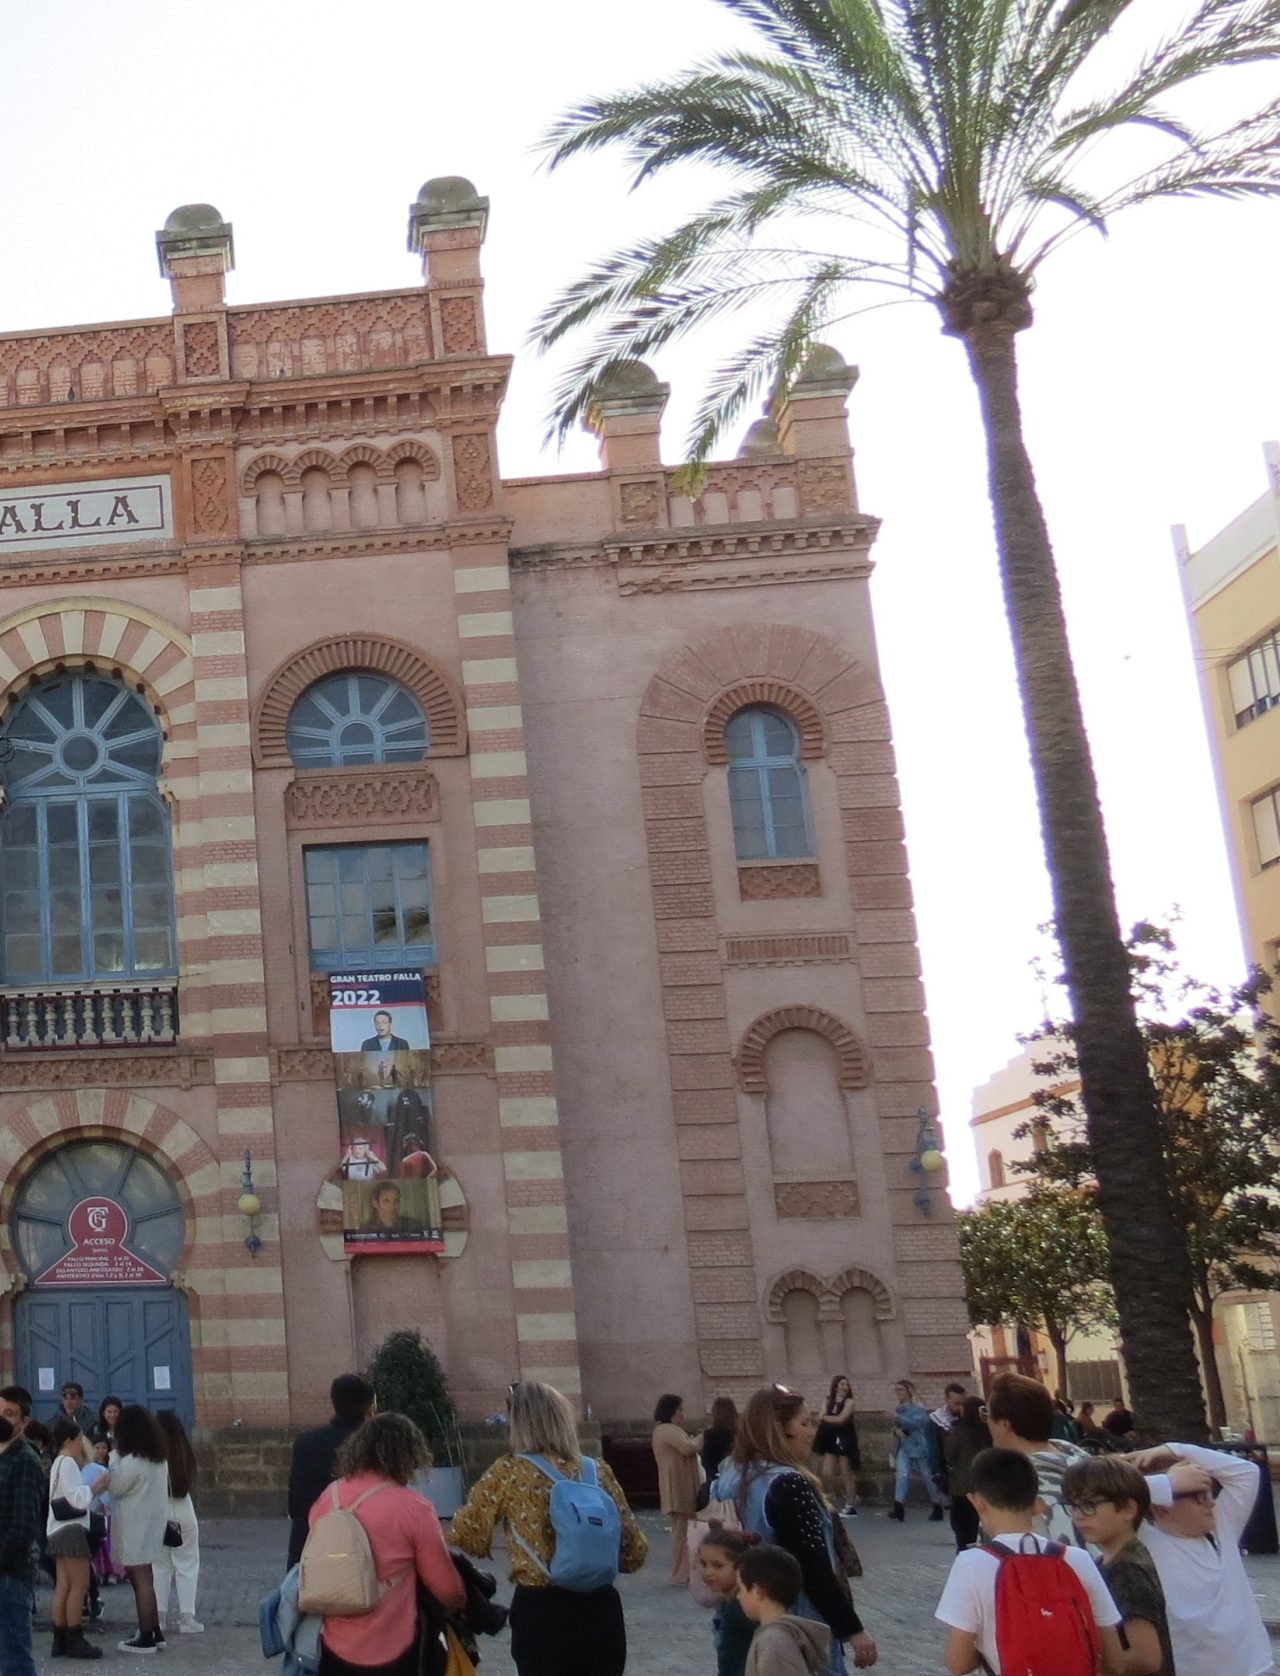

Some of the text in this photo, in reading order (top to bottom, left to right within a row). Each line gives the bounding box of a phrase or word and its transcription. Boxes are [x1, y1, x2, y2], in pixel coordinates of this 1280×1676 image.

[330, 973, 421, 983] GRAN TEATRO FALLA
[331, 990, 381, 1006] 2022
